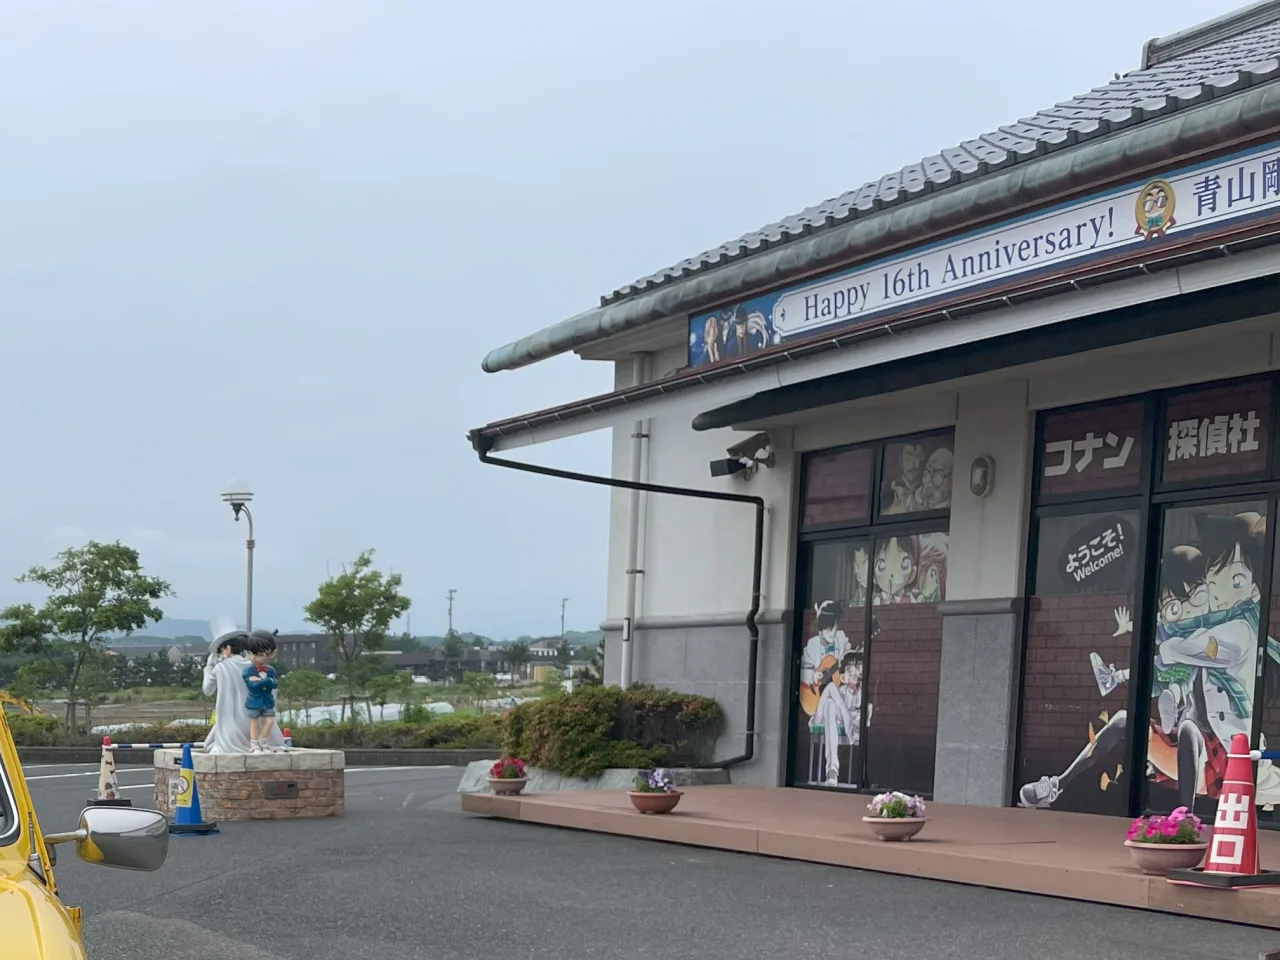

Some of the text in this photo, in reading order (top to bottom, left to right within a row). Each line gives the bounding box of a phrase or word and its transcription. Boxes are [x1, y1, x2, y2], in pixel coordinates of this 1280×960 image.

[804, 206, 1115, 322] Happy 16th Anniversary!
[1044, 410, 1260, 477] コナン 探偵社
[1065, 523, 1124, 573] ようこそ!
[1073, 543, 1124, 582] Welcome!
[1209, 792, 1251, 865] 出口
